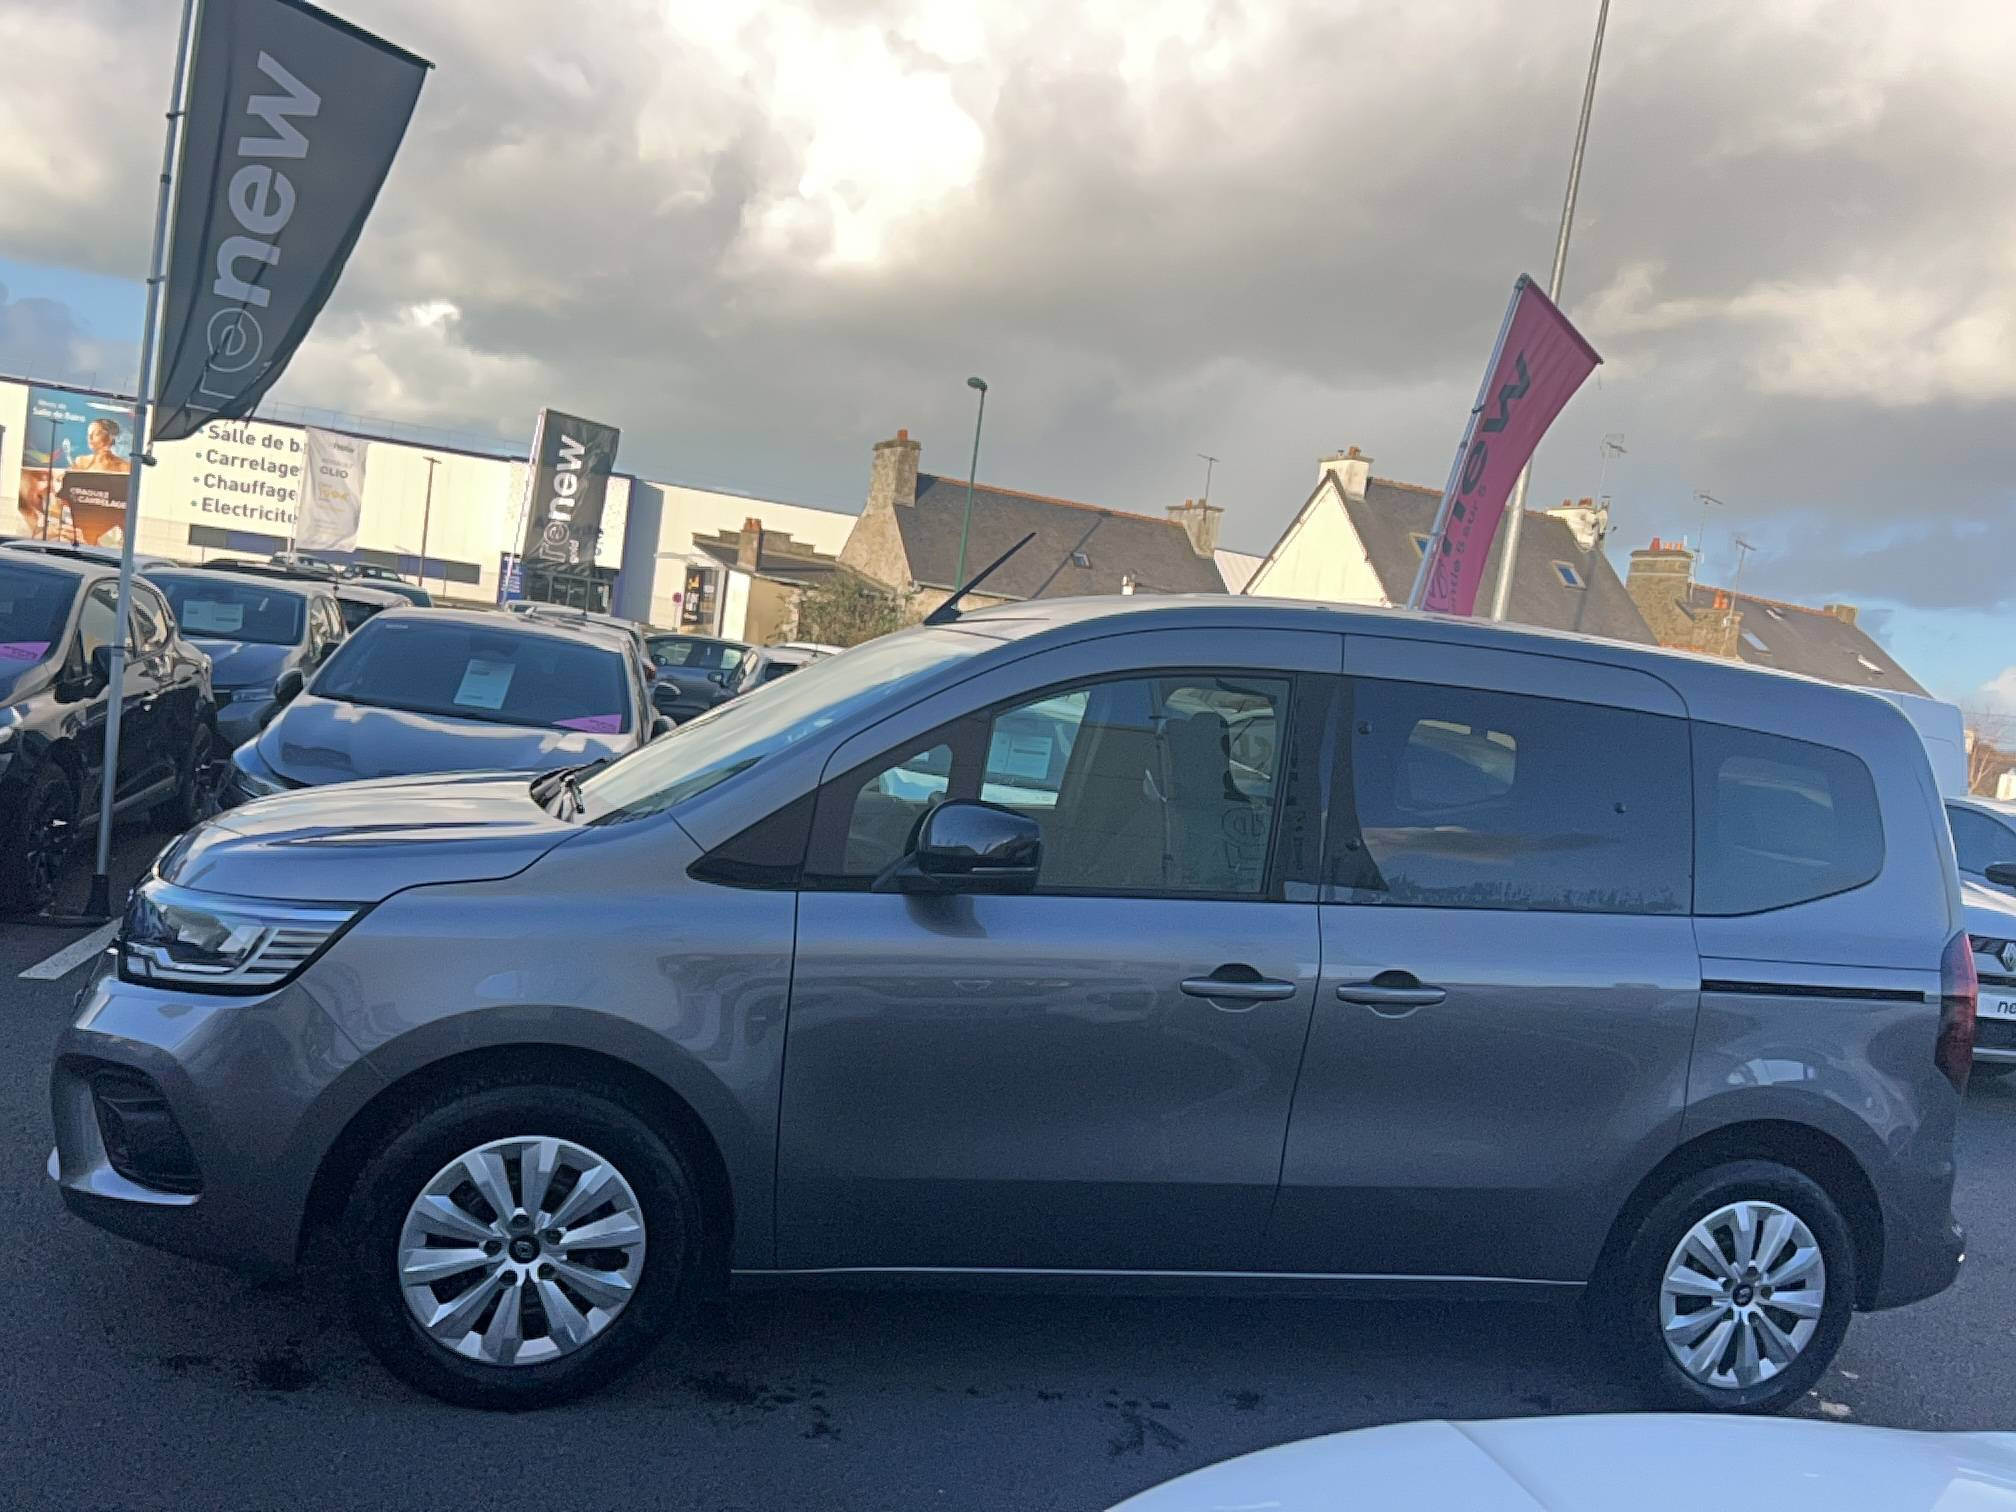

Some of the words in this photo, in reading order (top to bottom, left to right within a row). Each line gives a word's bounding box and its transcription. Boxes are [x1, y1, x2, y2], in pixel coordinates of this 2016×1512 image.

[208, 424, 256, 445] Salle
[261, 434, 284, 450] de
[290, 438, 303, 453] b
[206, 449, 300, 478] Carrelage
[319, 465, 349, 479] CLIO
[203, 472, 297, 502] Chauffage
[540, 434, 586, 563] renew
